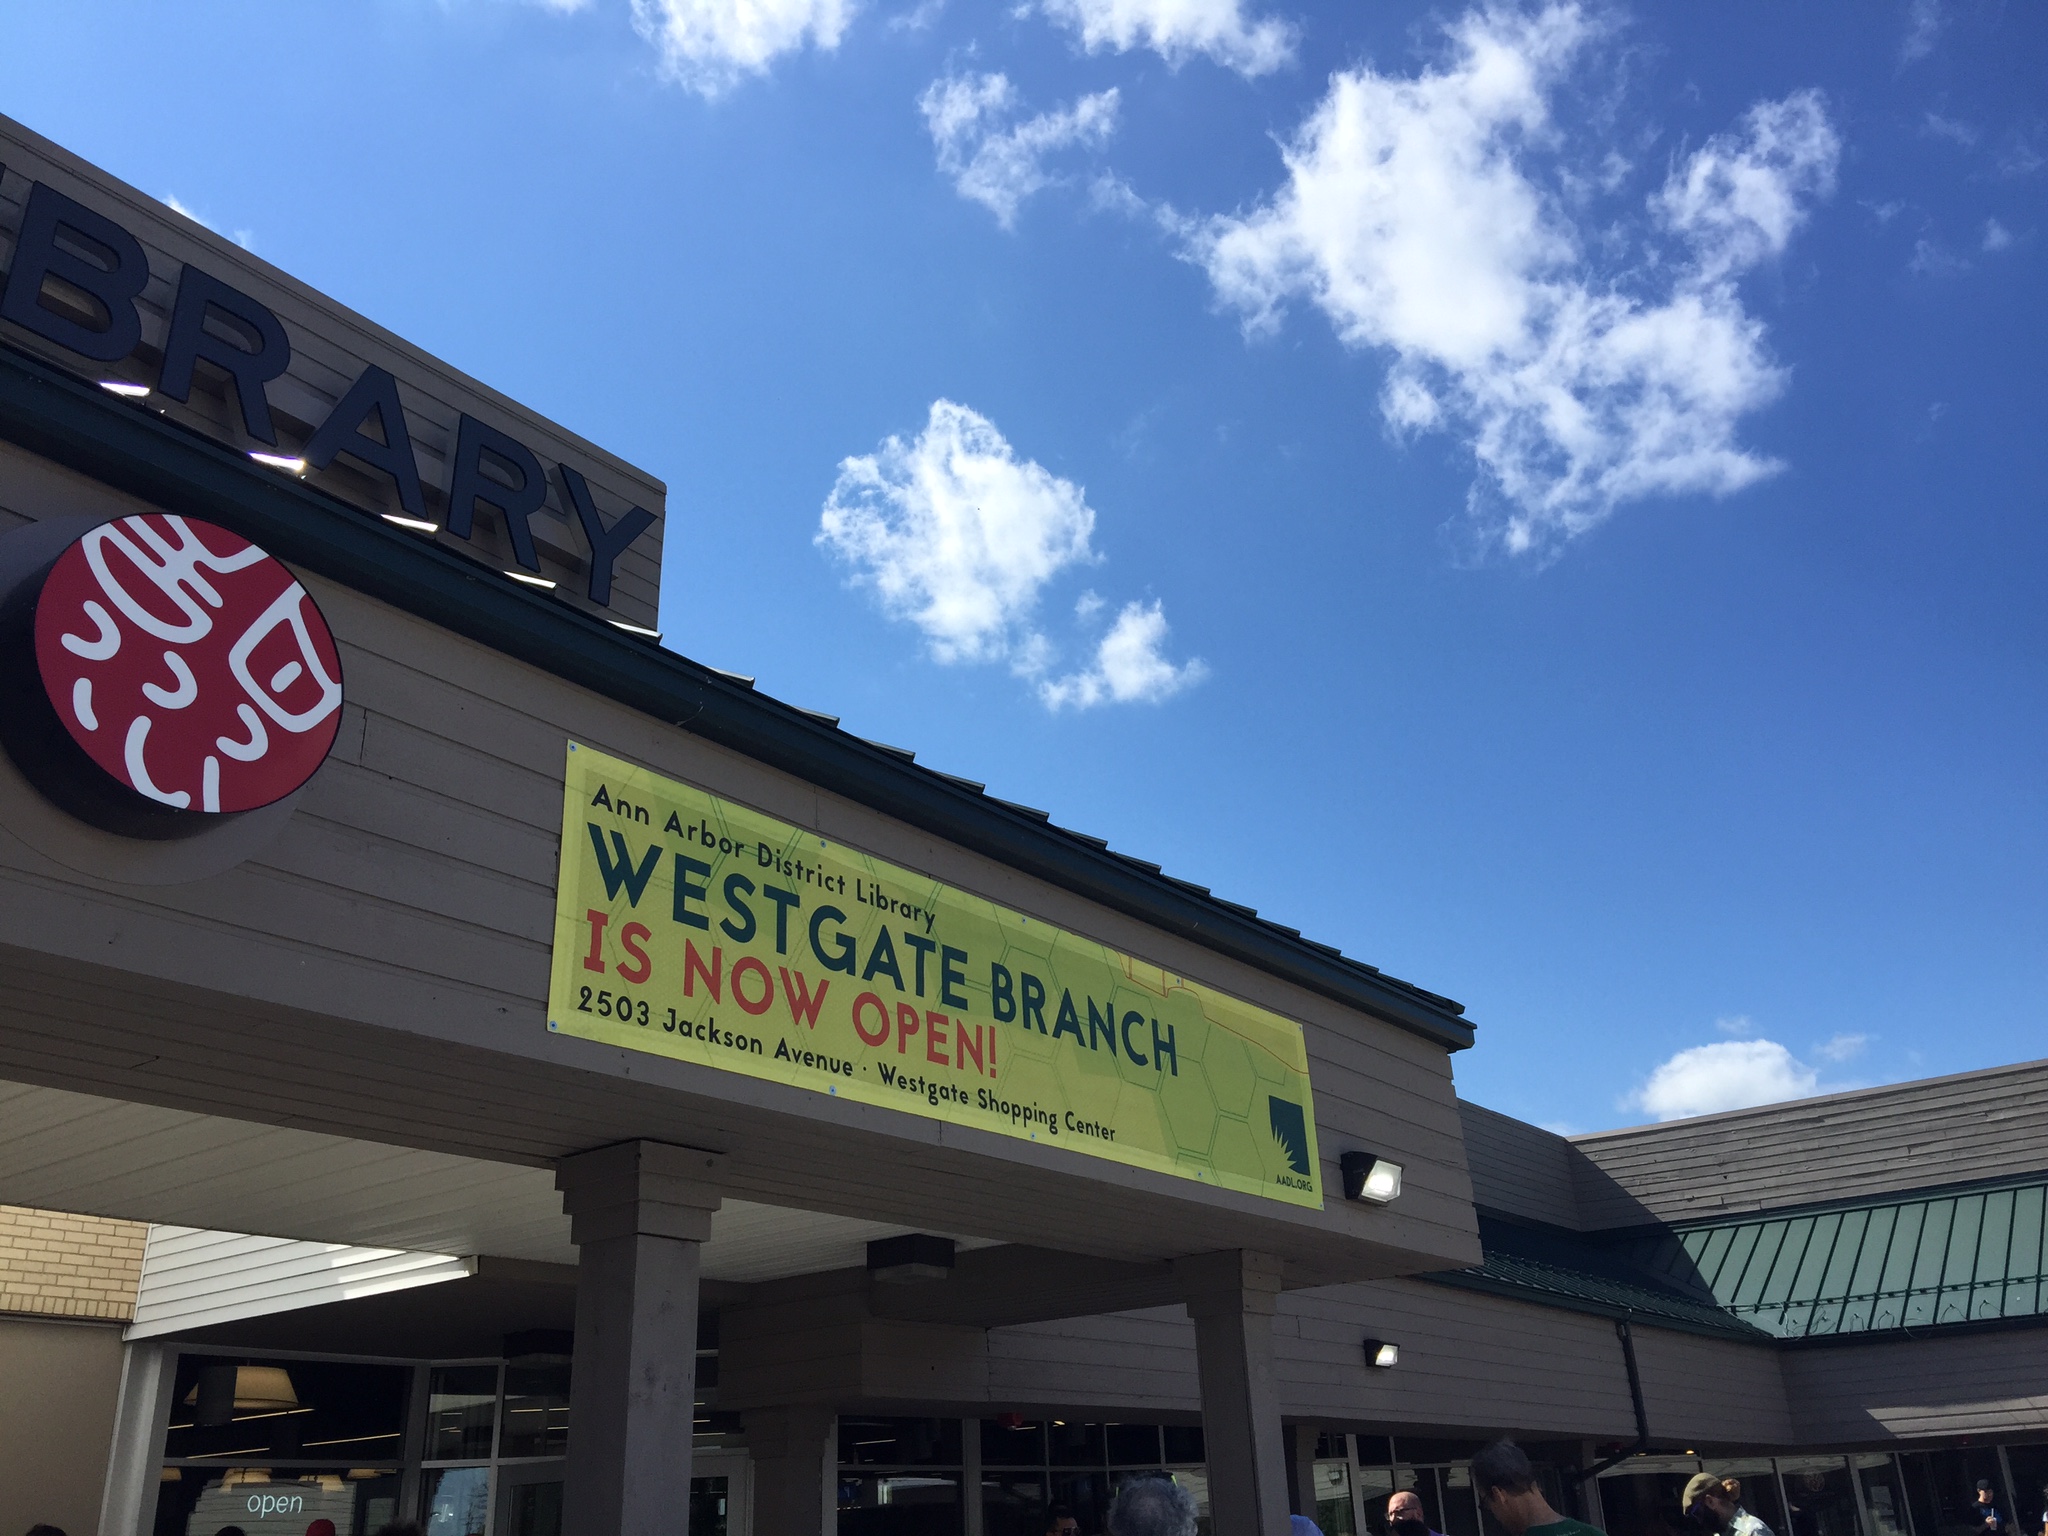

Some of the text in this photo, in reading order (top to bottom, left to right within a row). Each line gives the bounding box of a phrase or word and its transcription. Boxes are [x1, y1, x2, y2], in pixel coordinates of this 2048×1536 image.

[0, 162, 657, 607] BRARY
[591, 784, 936, 934] Ann Arbor District Library
[584, 909, 997, 1078] IS NOW OPEN!
[587, 822, 1178, 1077] WESTGATE BRANCH
[577, 986, 1116, 1141] 2503 Jackson Avenue Westgate Shopping Center
[1276, 1174, 1313, 1192] AADL.ORG
[247, 1494, 303, 1519] open
